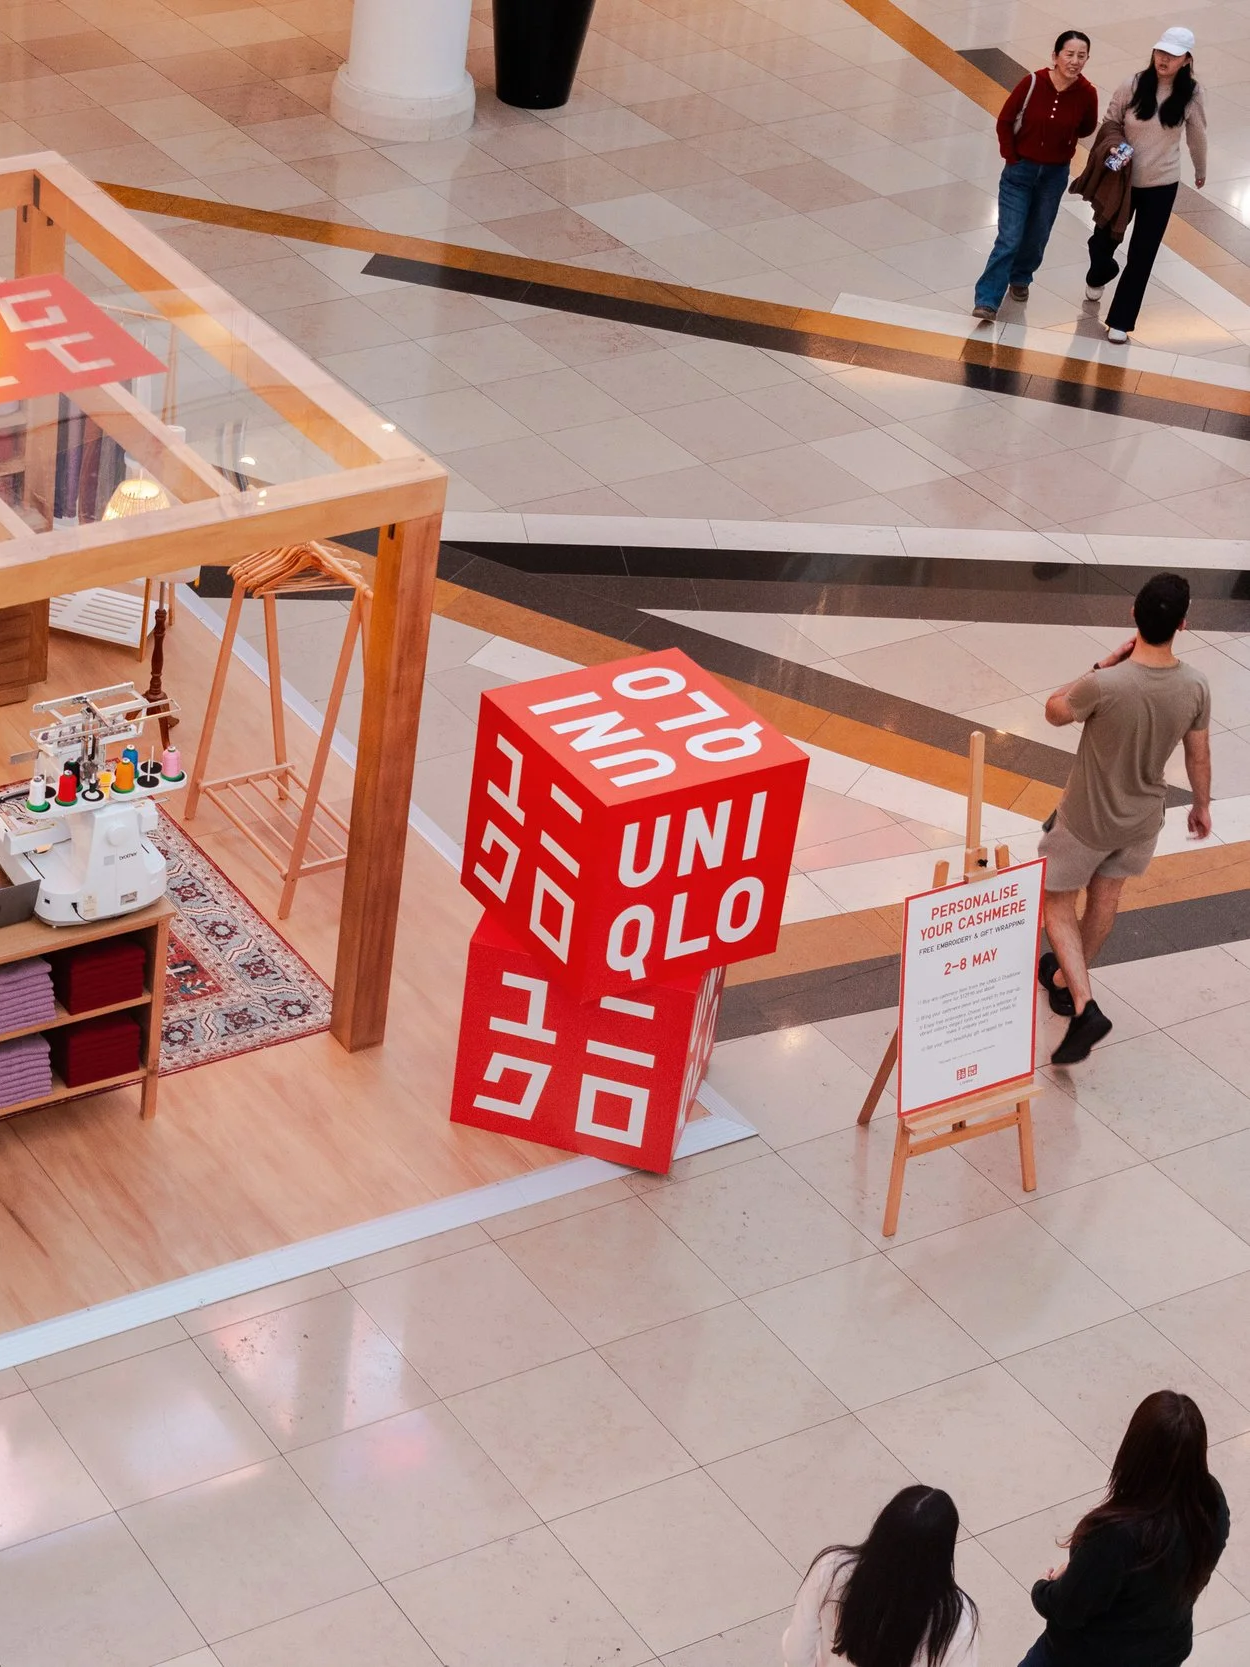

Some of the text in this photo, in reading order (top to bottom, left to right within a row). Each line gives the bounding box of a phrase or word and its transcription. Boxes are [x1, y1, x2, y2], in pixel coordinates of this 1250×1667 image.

[528, 691, 676, 788] UNI
[611, 667, 762, 762] QLO
[617, 790, 768, 888] UNI
[606, 876, 764, 981] QLO
[920, 899, 1027, 941] YOUR CASHMERE
[931, 884, 1019, 920] PERSONALISE
[918, 945, 934, 956] FREE
[936, 935, 972, 951] EMBROIDERY
[980, 928, 993, 938] GIFT
[995, 918, 1025, 933] WRAPPING
[972, 947, 998, 967] MAY
